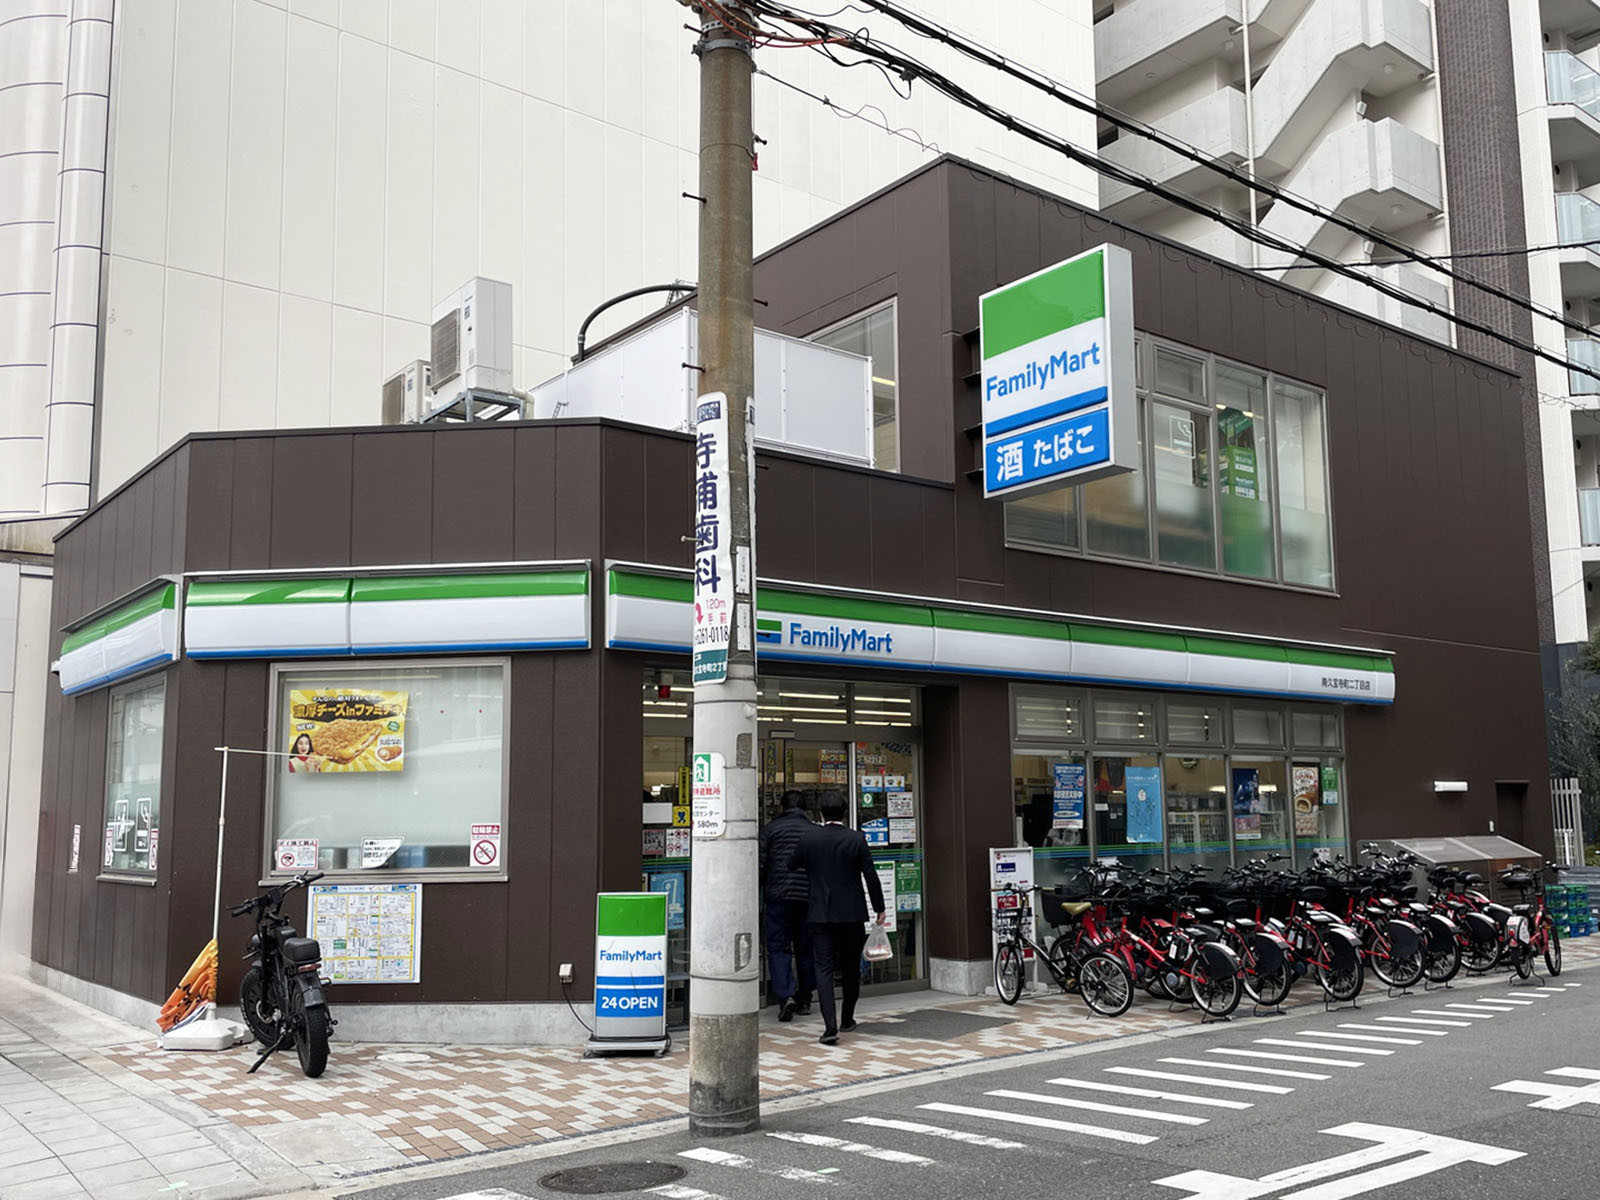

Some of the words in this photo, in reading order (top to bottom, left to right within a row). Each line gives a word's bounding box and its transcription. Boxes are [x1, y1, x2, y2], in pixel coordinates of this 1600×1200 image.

[986, 342, 1101, 402] FamilyMart
[996, 440, 1025, 483] 酒
[1032, 425, 1096, 469] たばこ
[790, 622, 893, 653] FamilyMart
[600, 950, 662, 962] FamilyMart
[601, 996, 618, 1009] 24
[618, 996, 658, 1010] OPEN
